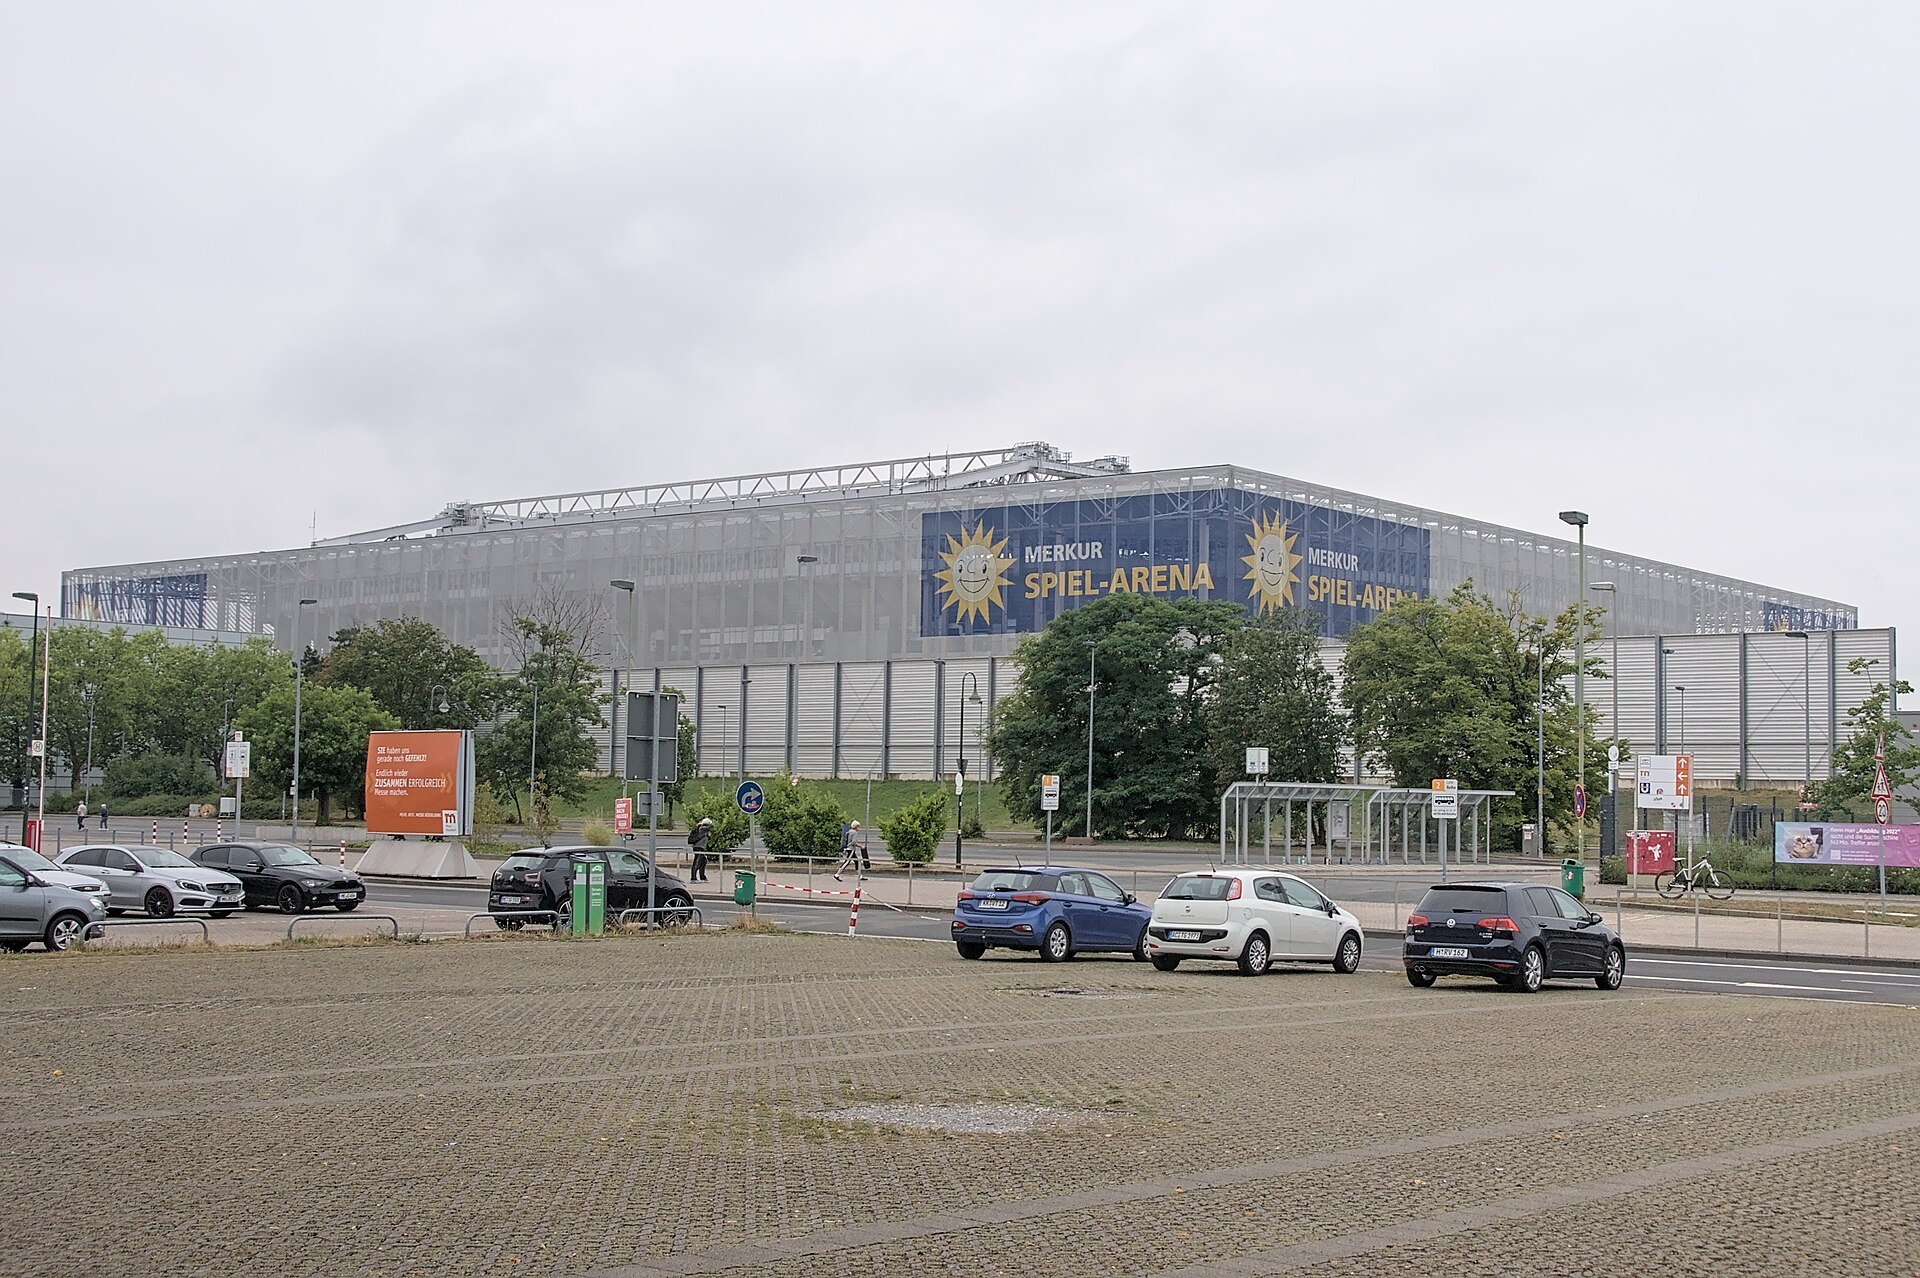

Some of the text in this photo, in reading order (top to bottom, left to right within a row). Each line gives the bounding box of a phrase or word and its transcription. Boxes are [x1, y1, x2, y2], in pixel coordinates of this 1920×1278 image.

[1025, 541, 1103, 563] MERKUR
[1308, 547, 1359, 572] MERKUR
[1024, 562, 1215, 599] SPIEL-ARENA
[377, 746, 386, 754] SIE
[387, 746, 401, 754] haben
[405, 754, 427, 762] GEFEHLT!
[375, 769, 408, 777] Endlich wieder
[375, 778, 446, 788] ZUSAMMEN ERFOLGREICH
[1436, 781, 1441, 790] 2
[374, 788, 409, 796] Messe machen.
[1877, 804, 1887, 817] 20
[1856, 827, 1886, 835] „Ausbildug
[1453, 949, 1466, 957] 162
